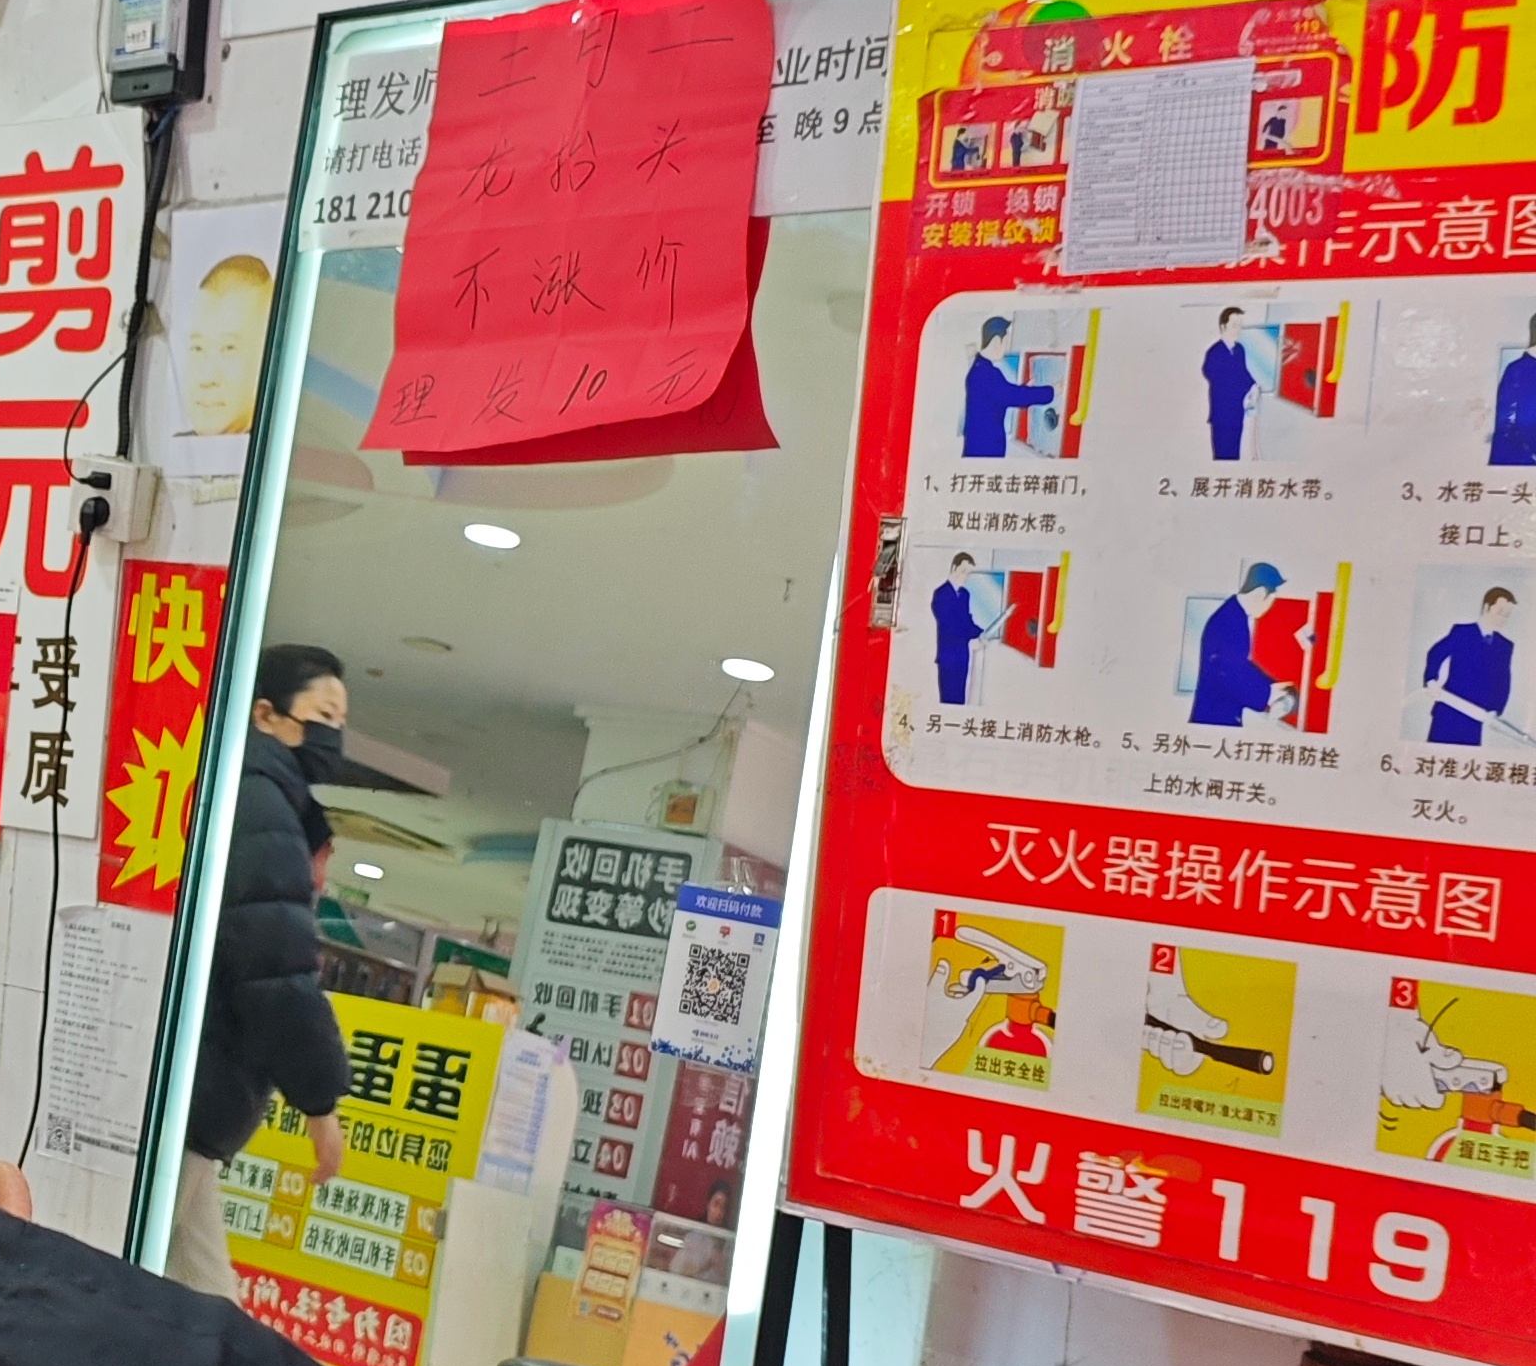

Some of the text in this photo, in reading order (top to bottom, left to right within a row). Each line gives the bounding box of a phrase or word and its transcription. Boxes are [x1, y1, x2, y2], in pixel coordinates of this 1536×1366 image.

[1040, 25, 1194, 74] 消火栓
[324, 137, 423, 175] 请打电话
[313, 194, 357, 224] 181
[454, 236, 685, 334] 不涨价
[128, 572, 227, 689] 快
[1380, 754, 1536, 787] 6、对准火源根
[982, 822, 1502, 942] 灭火器操作示意图
[939, 913, 951, 935] 1
[1155, 948, 1172, 973] 2
[1394, 981, 1413, 1006] 3
[974, 1054, 1046, 1083] 拉出安全栓
